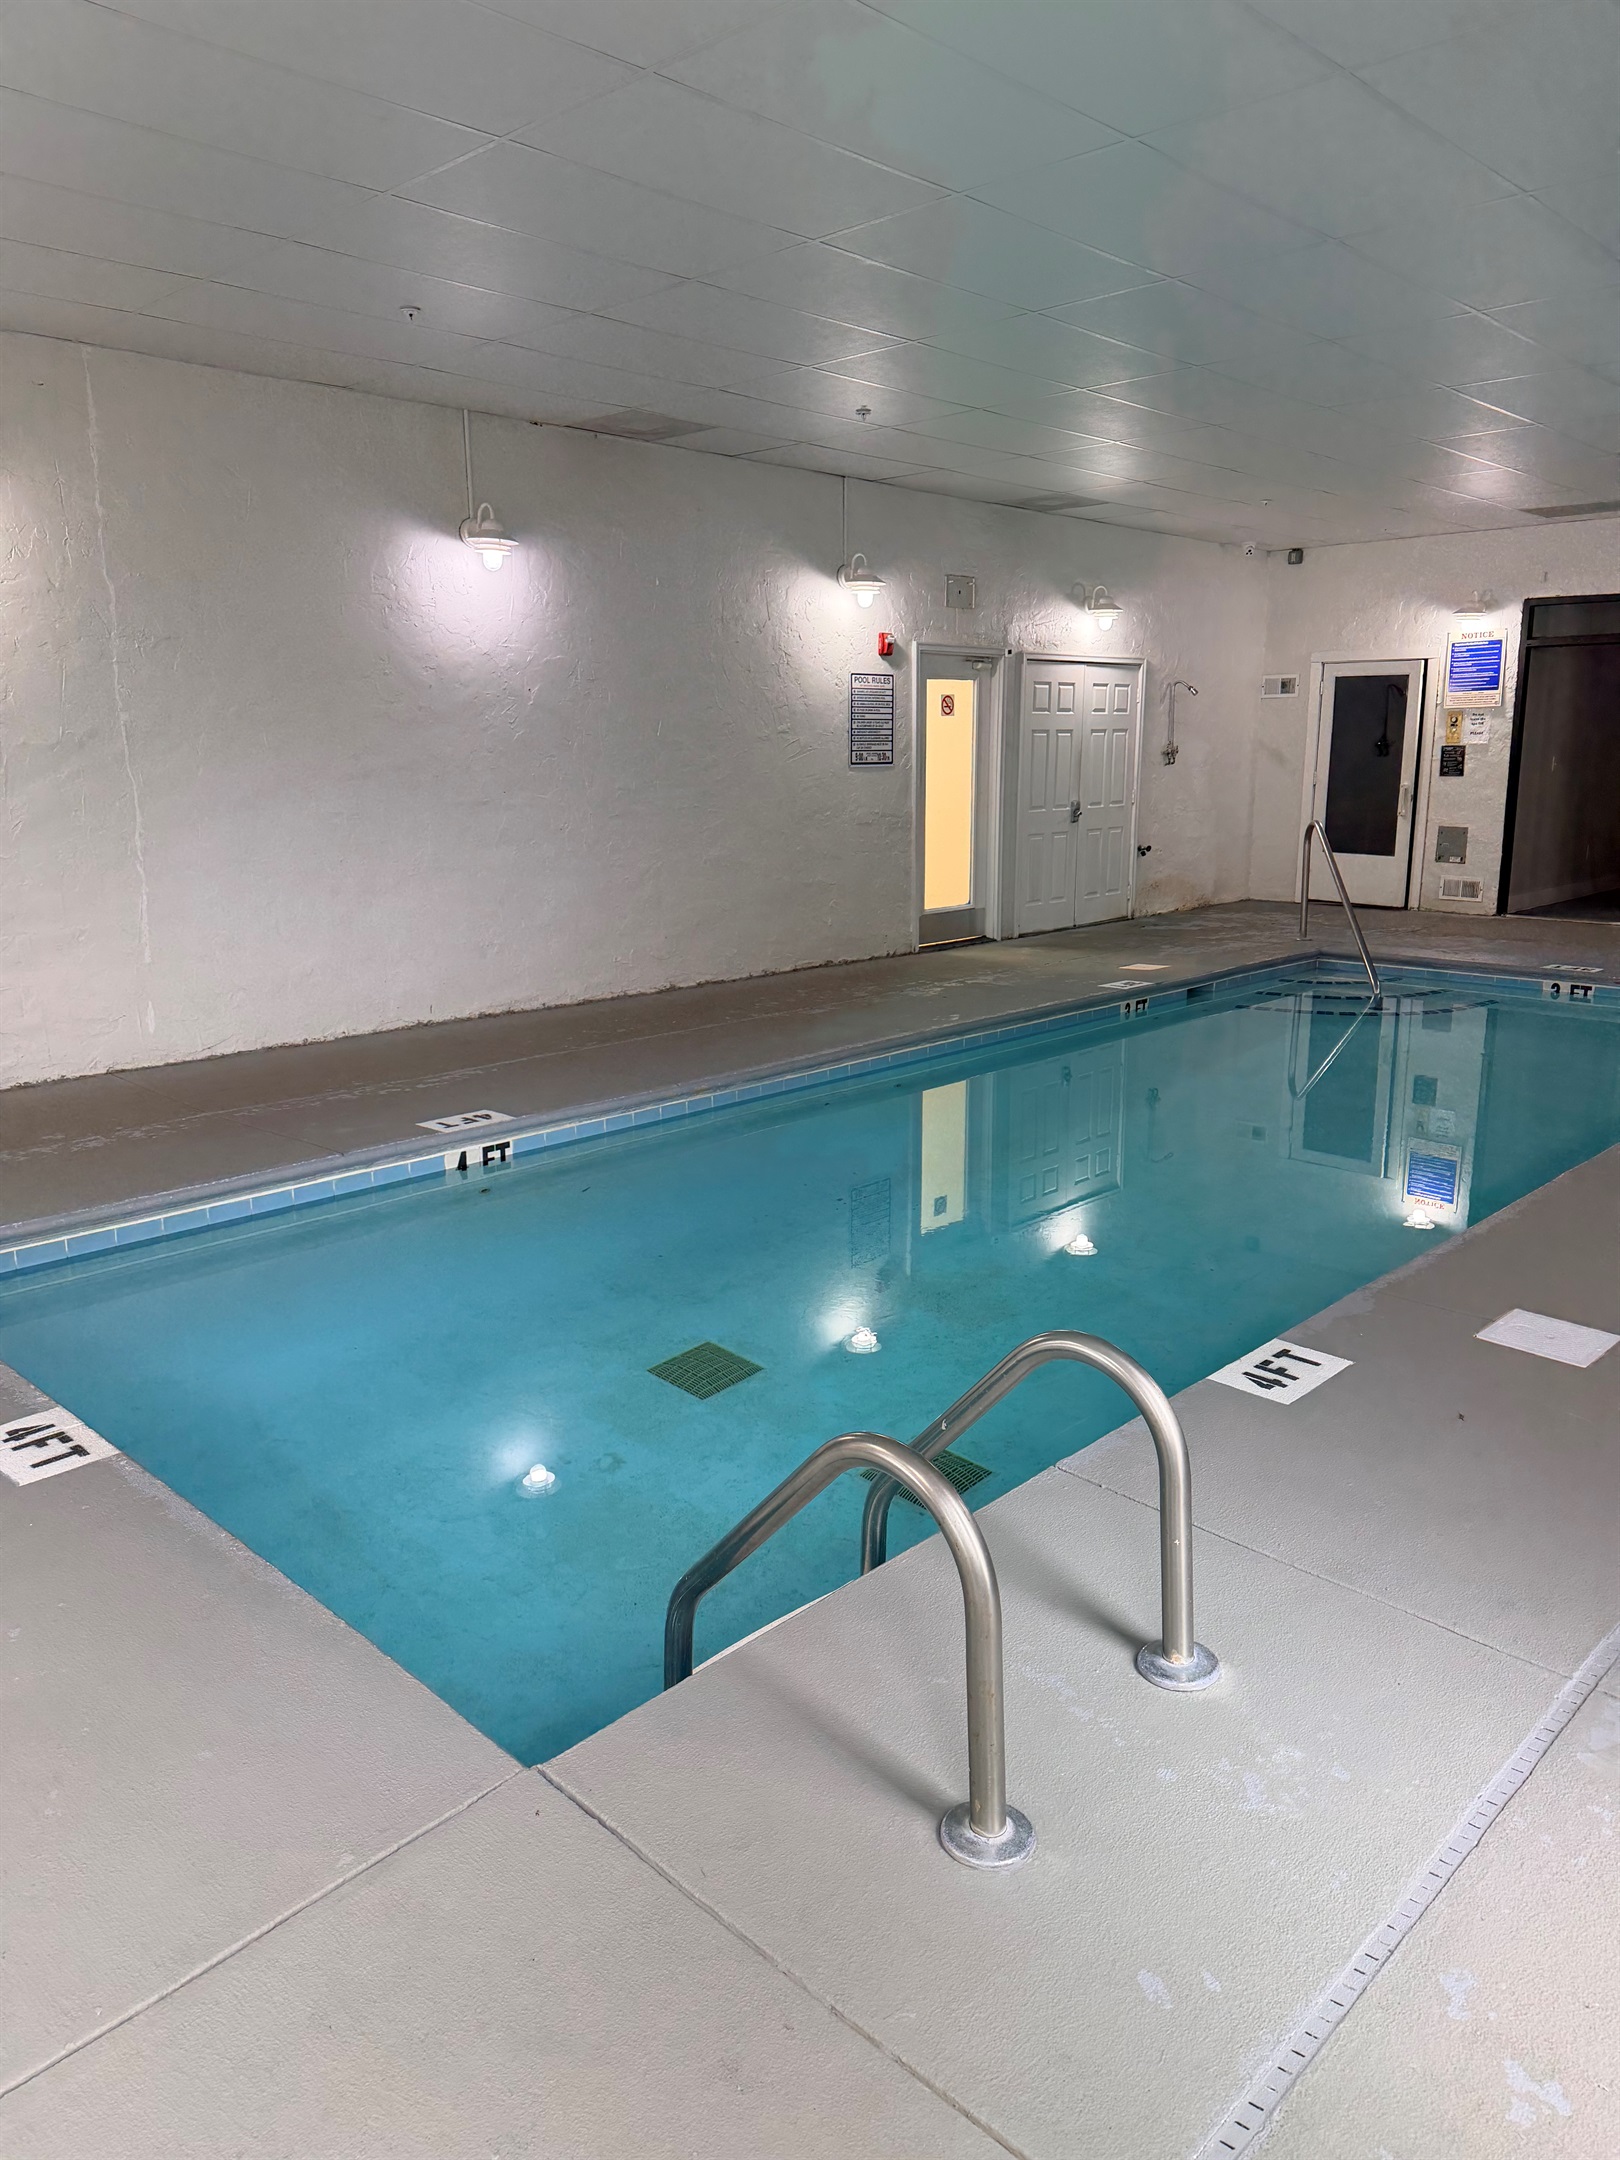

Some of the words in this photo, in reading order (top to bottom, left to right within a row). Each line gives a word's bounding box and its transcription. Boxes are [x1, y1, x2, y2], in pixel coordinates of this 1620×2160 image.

[1461, 631, 1494, 639] NOTICE
[1570, 984, 1592, 996] FT
[1136, 998, 1148, 1012] FT
[482, 1141, 510, 1166] FT
[1242, 1348, 1322, 1390] 4FT
[2, 1423, 90, 1468] 4FT
